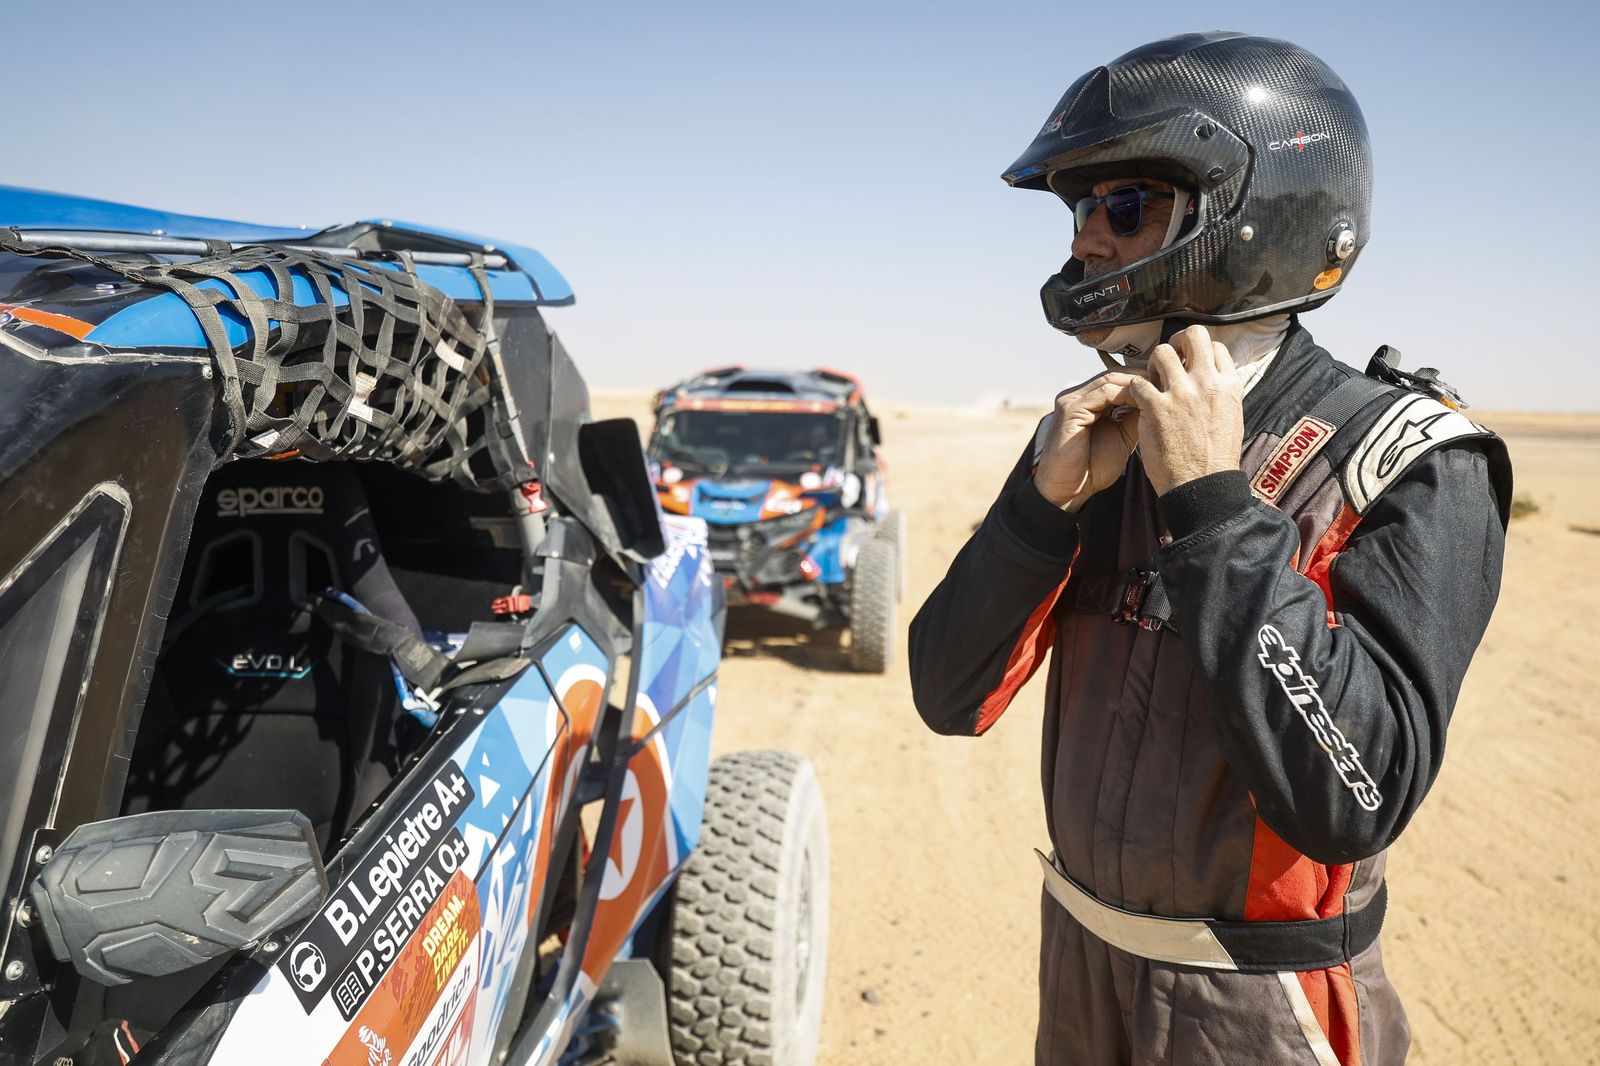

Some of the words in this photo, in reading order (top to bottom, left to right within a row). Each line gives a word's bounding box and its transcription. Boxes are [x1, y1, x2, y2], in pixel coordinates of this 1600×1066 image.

[1269, 131, 1331, 151] CARBON
[1073, 283, 1121, 305] VENTI
[1257, 423, 1321, 494] SIMPSON
[217, 486, 324, 517] sparco
[232, 654, 283, 670] EVO
[1257, 625, 1384, 811] alpinestars
[324, 802, 442, 946] B.Lepietre
[433, 773, 466, 816] A+
[356, 868, 445, 986] P.SERRA
[422, 895, 466, 958] DREAM.
[433, 922, 462, 974] DARE.
[436, 951, 458, 992] LIVE
